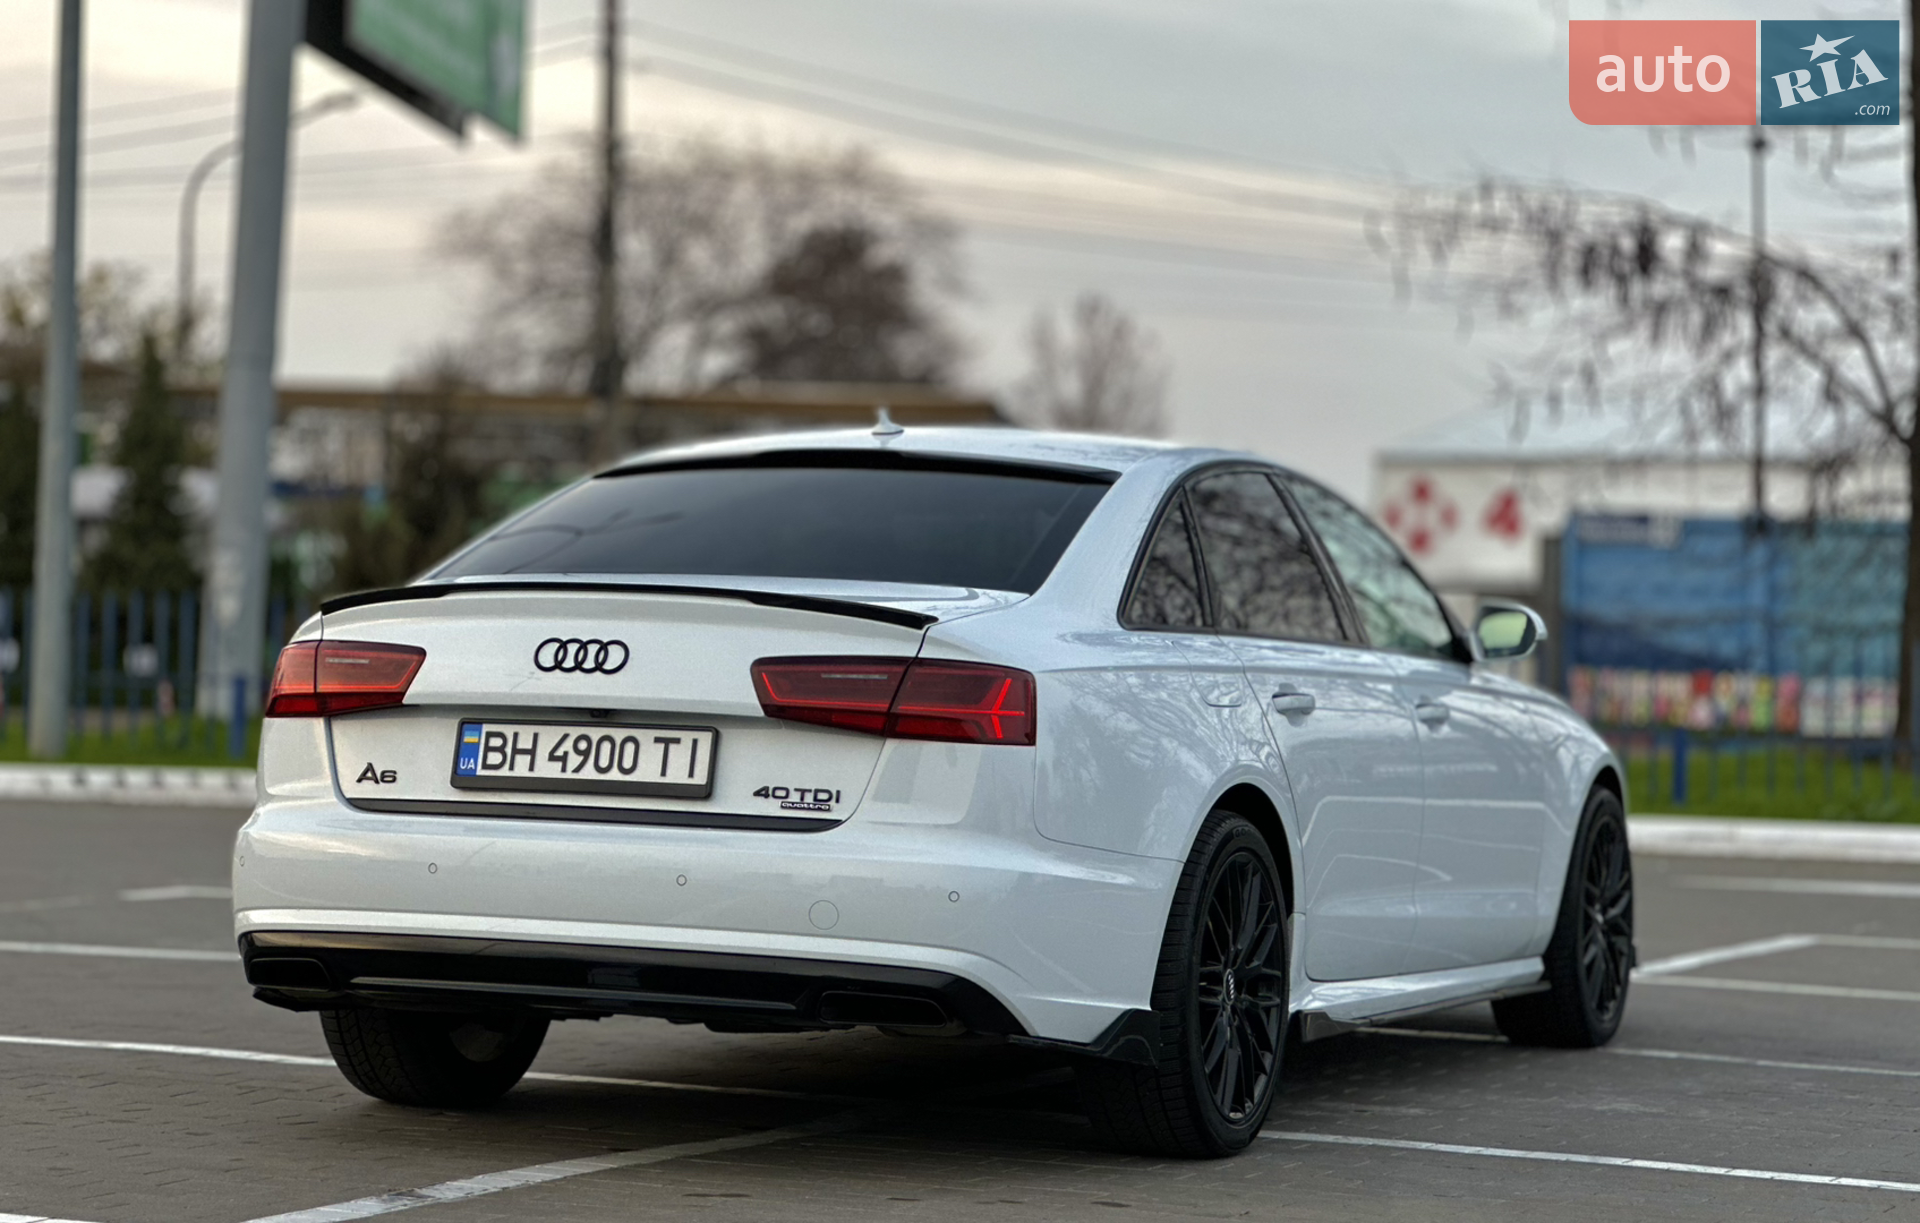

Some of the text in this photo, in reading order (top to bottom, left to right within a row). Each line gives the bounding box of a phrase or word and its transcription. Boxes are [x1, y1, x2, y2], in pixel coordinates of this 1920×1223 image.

[459, 757, 476, 770] UA
[480, 730, 699, 779] BH 4900 TI
[356, 761, 398, 785] A6
[752, 785, 841, 804] 40 TDI
[781, 802, 830, 811] quattro
